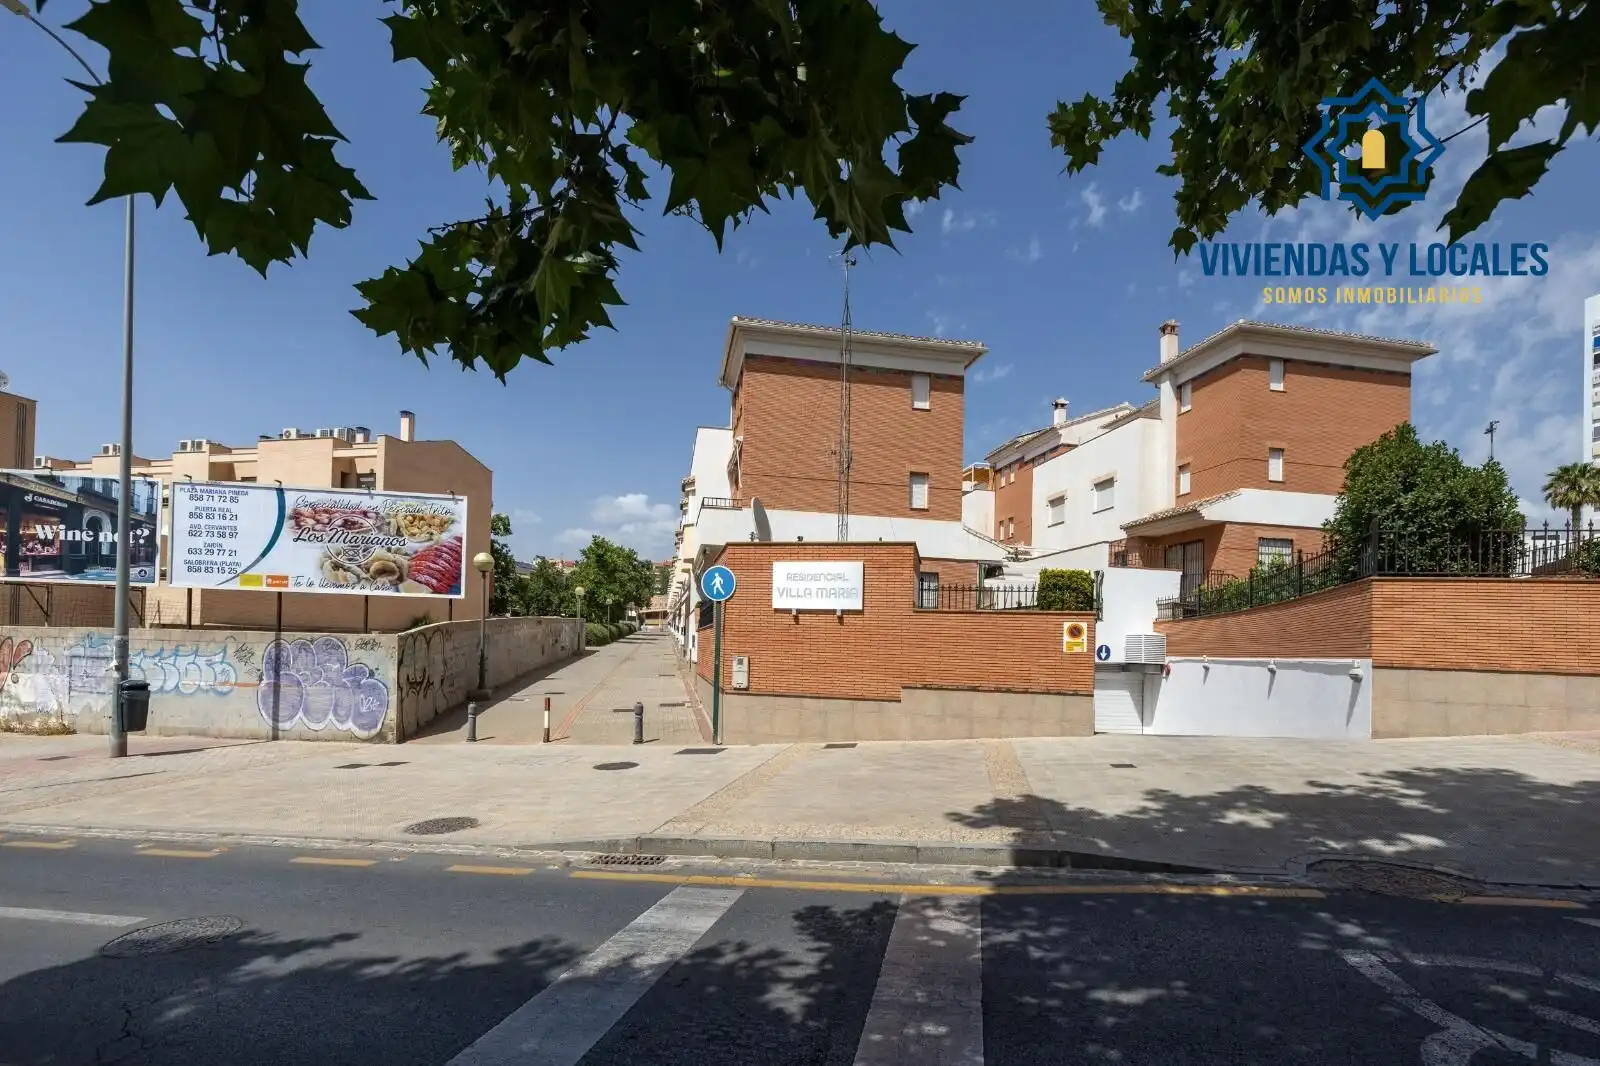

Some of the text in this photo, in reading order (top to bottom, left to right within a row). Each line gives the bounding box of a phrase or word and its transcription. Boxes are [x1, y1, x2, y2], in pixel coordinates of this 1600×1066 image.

[206, 494, 215, 502] 71
[217, 495, 227, 503] 72
[205, 512, 215, 520] 83
[217, 513, 227, 521] 16
[35, 524, 95, 542] Wine
[205, 530, 215, 538] 73
[216, 531, 227, 539] 58
[293, 526, 408, 547] Los Marianos
[204, 548, 214, 556] 29
[228, 549, 237, 557] 21
[219, 560, 242, 568] (PLAYA)
[204, 566, 214, 574] 83
[227, 567, 238, 575] 25
[786, 572, 849, 582] RESIDENCIAL
[291, 576, 303, 587] Te
[306, 577, 315, 588] lo
[319, 577, 356, 590] llevamos
[777, 587, 813, 599] VILLA
